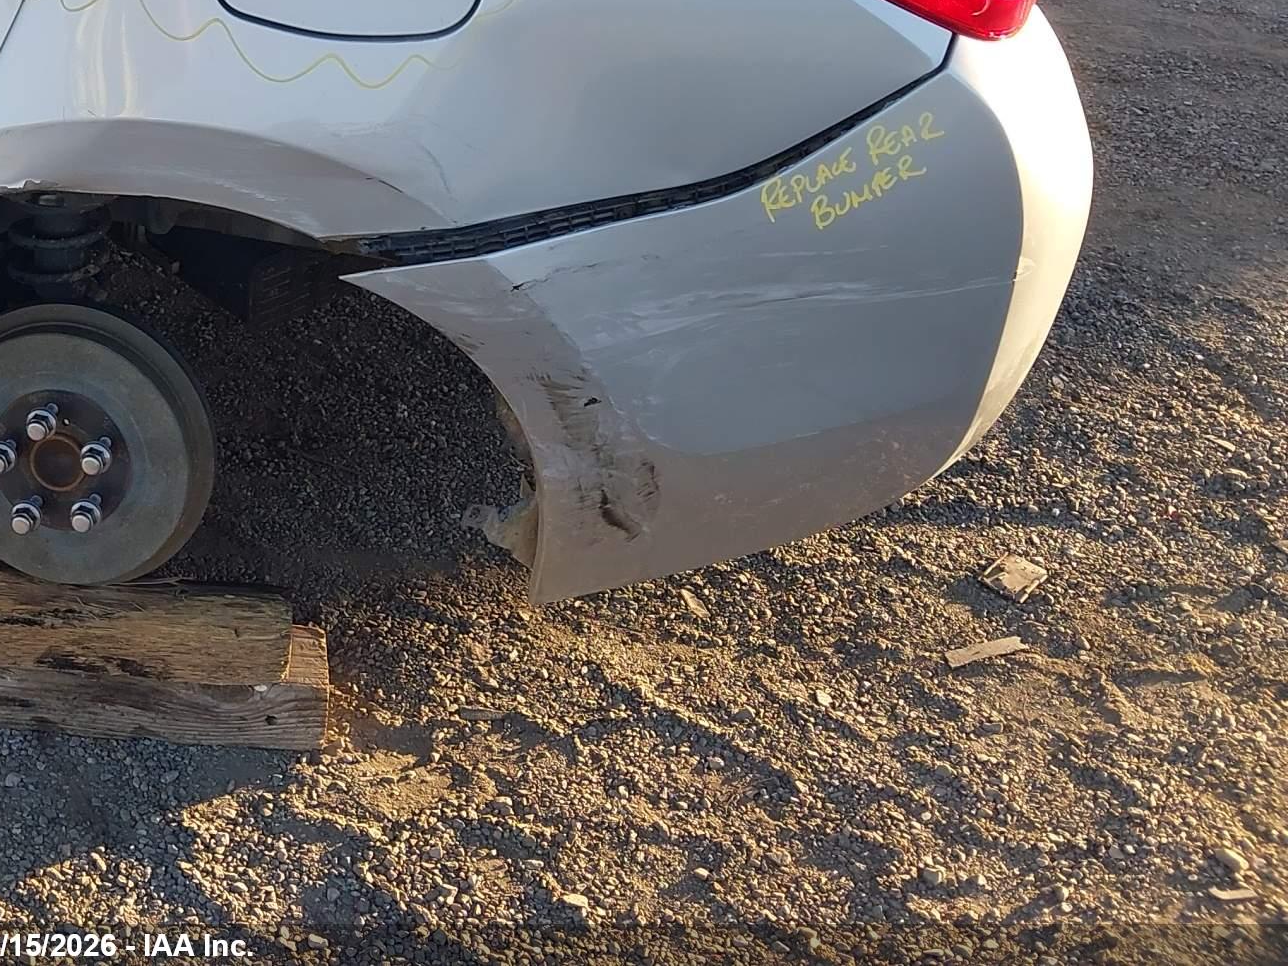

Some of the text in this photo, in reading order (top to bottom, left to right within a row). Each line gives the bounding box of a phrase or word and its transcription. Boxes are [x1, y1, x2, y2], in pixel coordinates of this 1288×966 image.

[761, 112, 945, 223] REPLACE REAR
[811, 155, 927, 229] BUMPER
